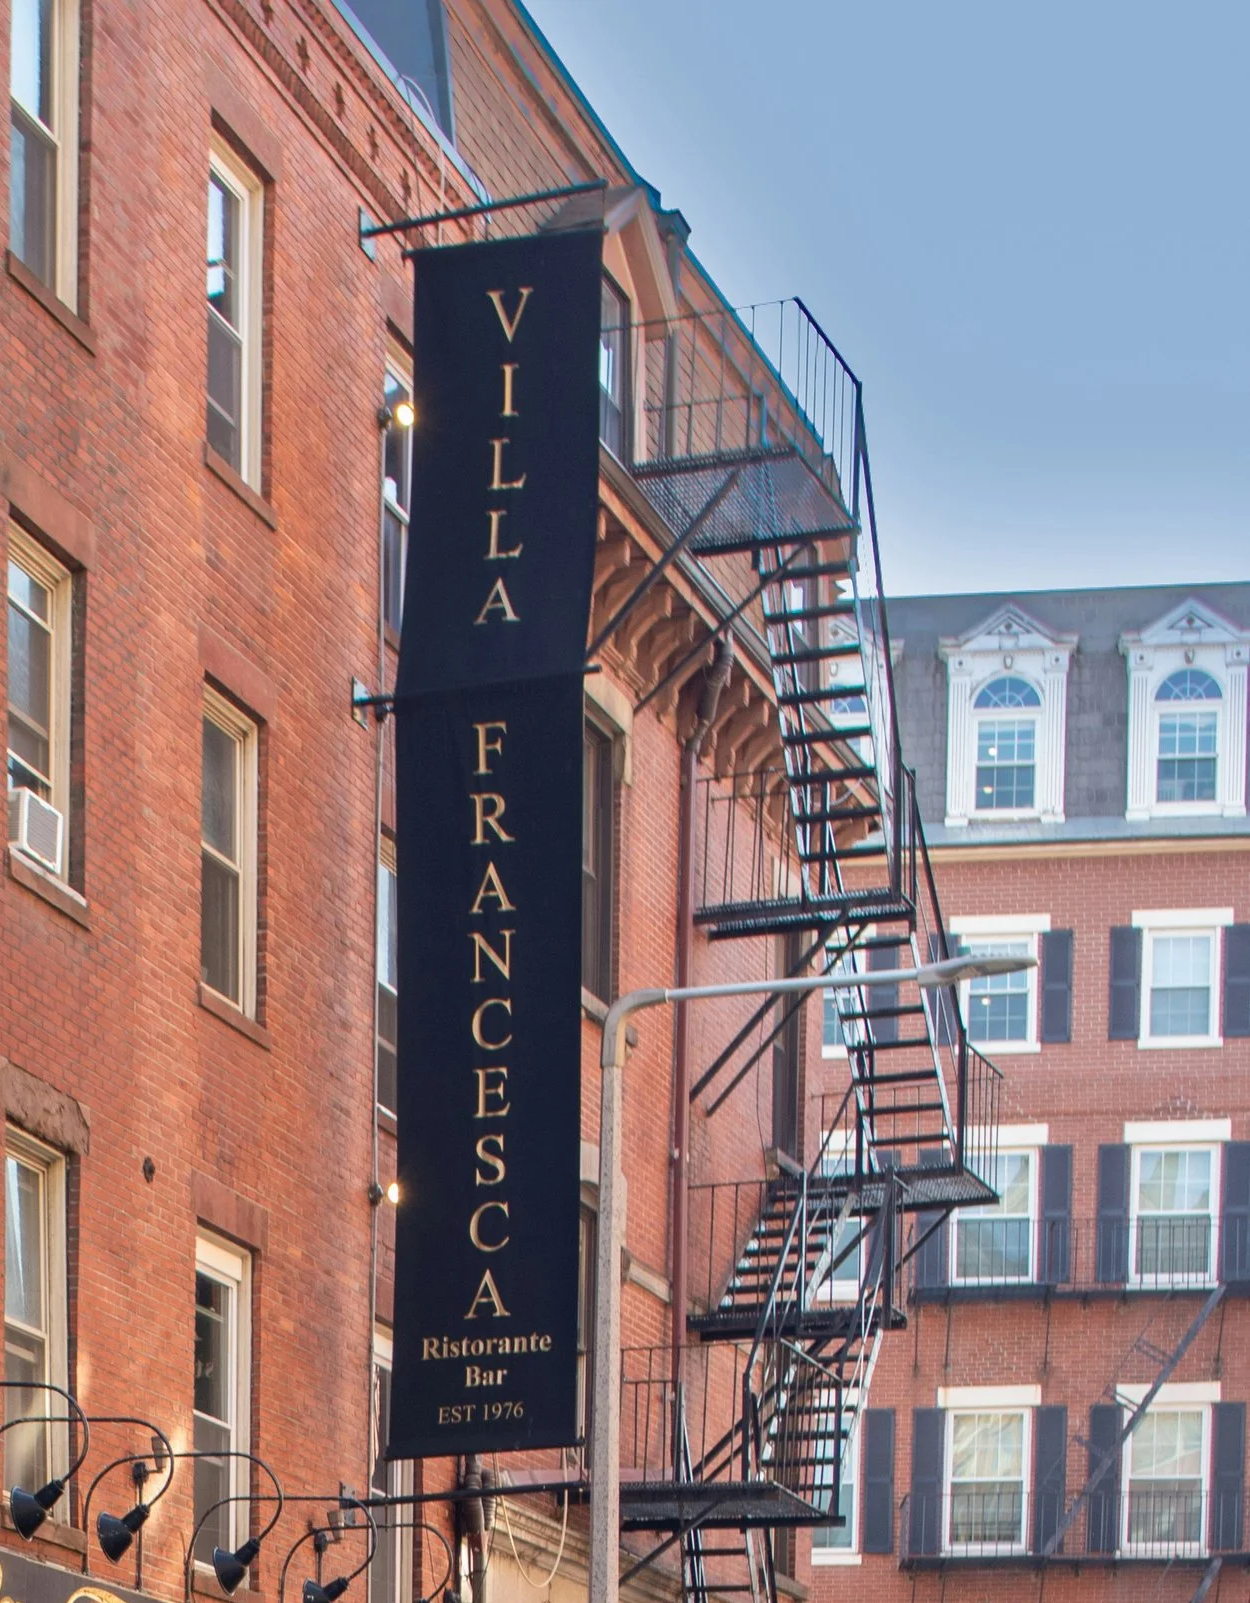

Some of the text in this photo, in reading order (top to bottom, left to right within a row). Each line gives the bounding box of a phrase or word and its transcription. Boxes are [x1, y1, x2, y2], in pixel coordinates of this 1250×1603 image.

[473, 286, 535, 627] VILLA
[463, 721, 517, 1321] FRANCESCA
[421, 1330, 553, 1362] Ristorante
[463, 1361, 509, 1391] Bar
[437, 1399, 525, 1426] EST 1976
